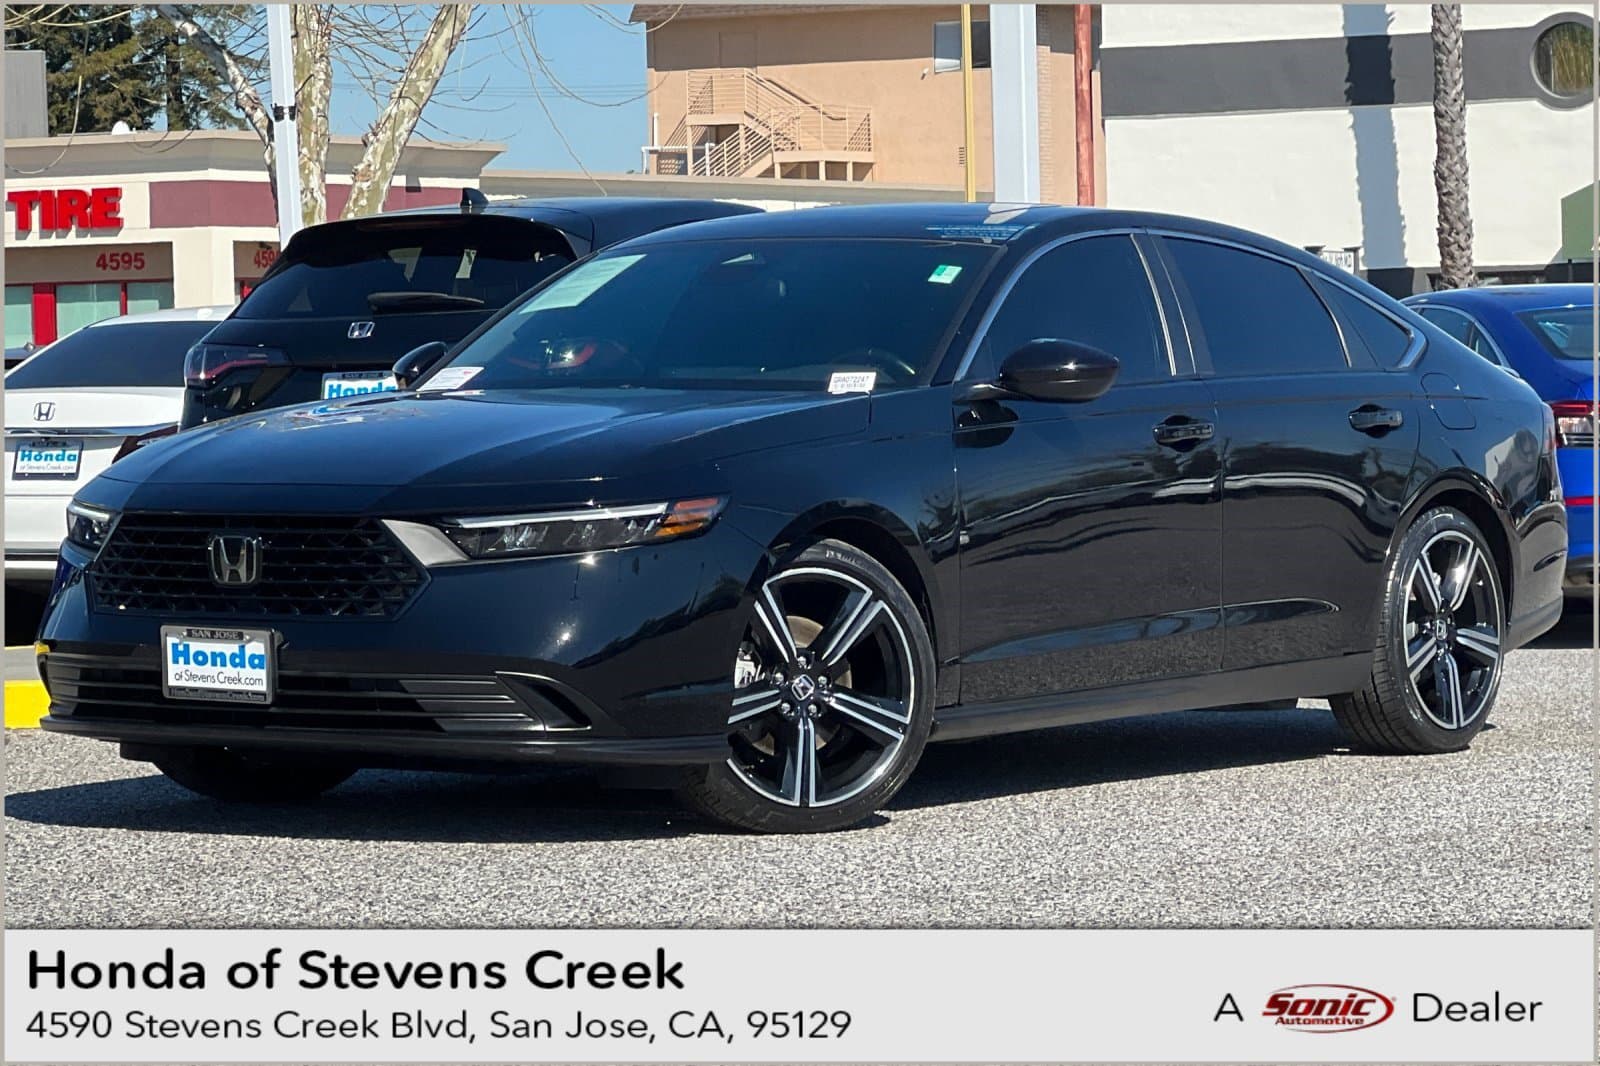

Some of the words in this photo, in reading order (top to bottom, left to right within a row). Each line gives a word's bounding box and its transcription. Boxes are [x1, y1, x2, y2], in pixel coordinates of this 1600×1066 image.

[7, 187, 123, 233] TIRE
[95, 252, 145, 271] 4595
[20, 449, 77, 462] Honda
[191, 629, 211, 639] SAN
[213, 631, 240, 640] JOSE
[171, 642, 265, 670] Honda
[174, 671, 183, 682] of
